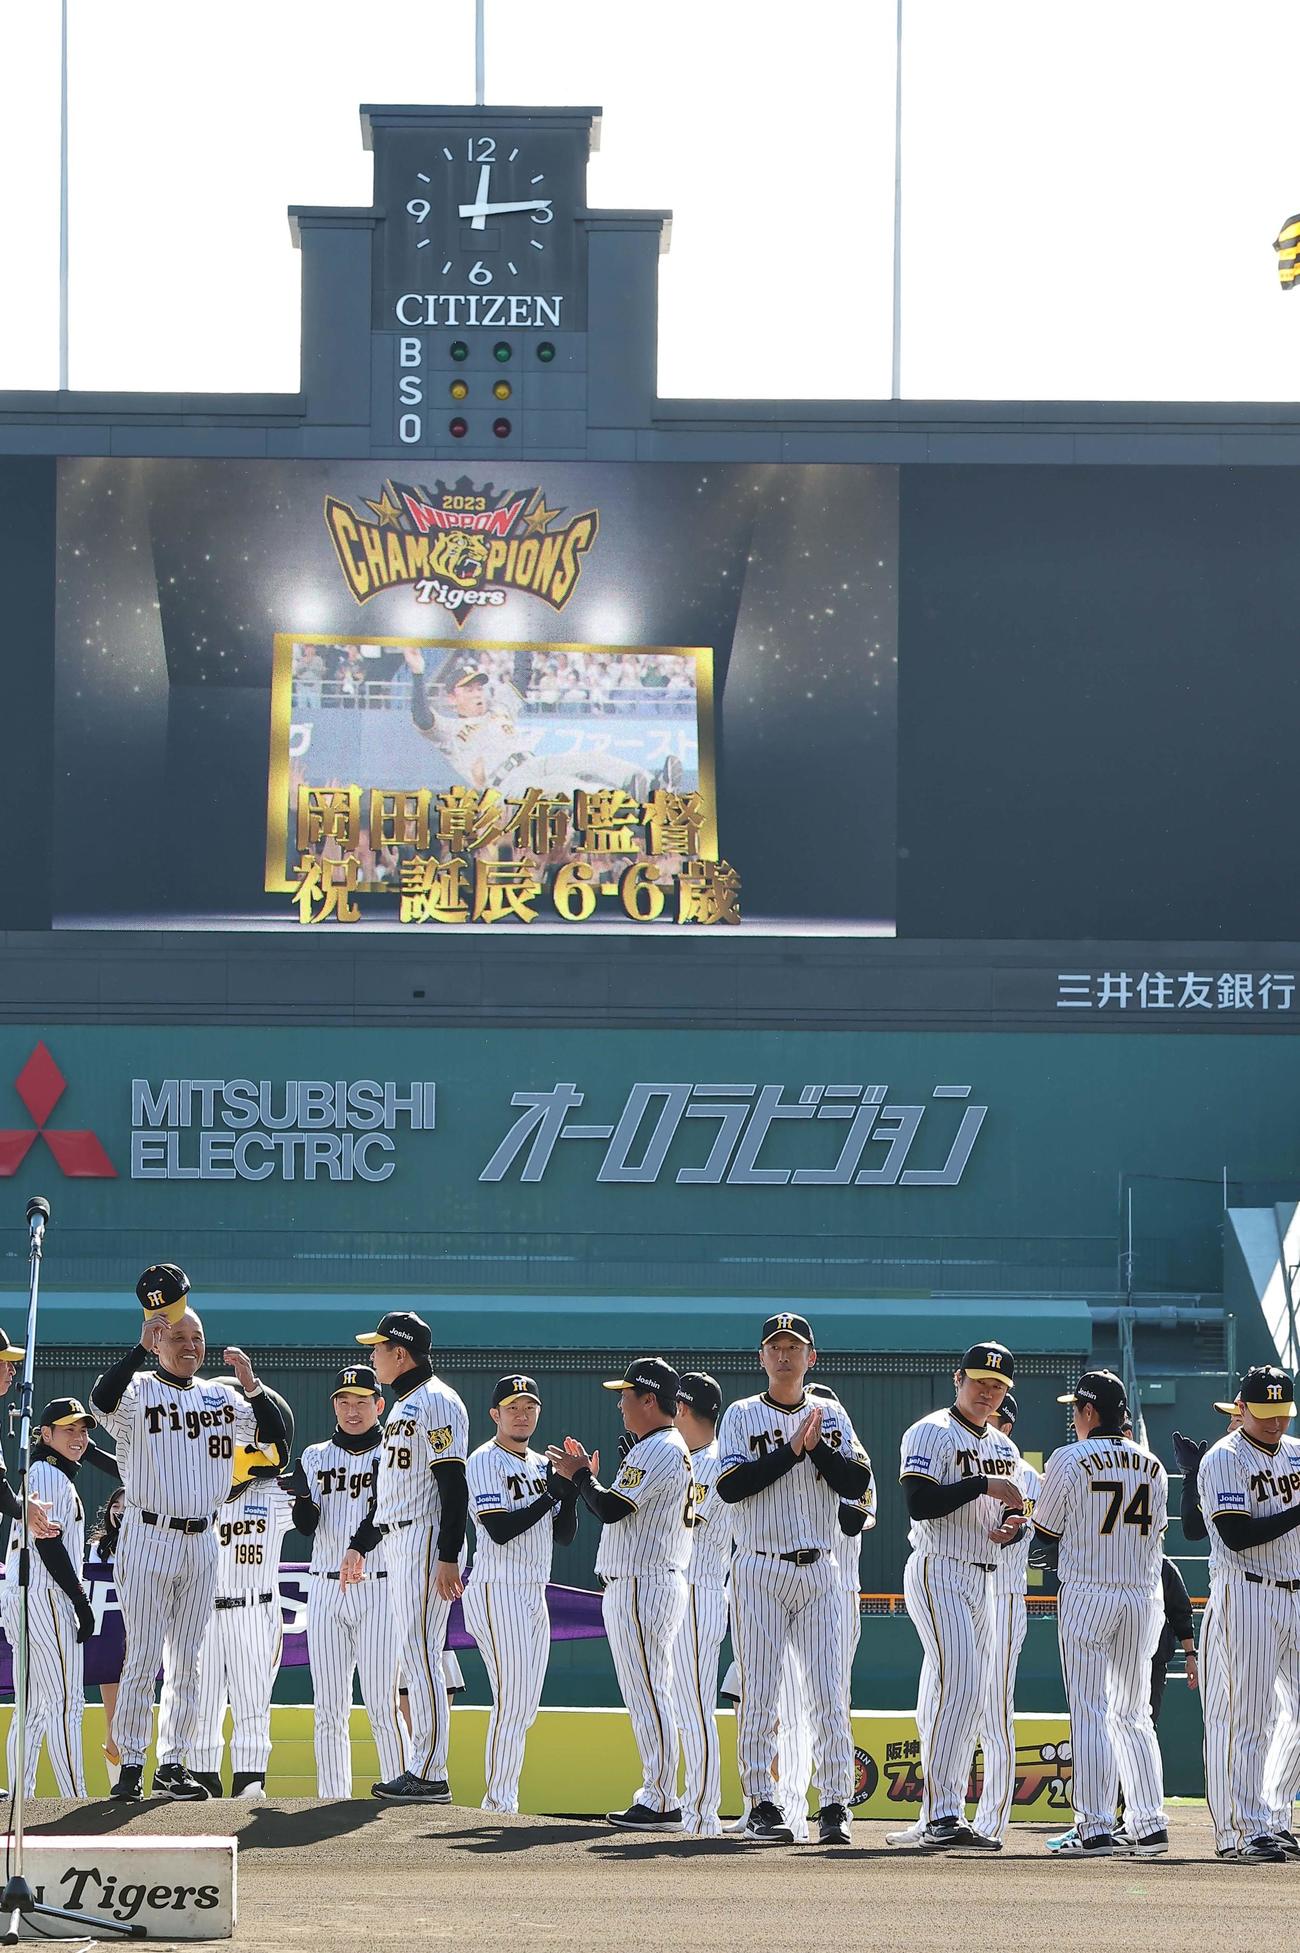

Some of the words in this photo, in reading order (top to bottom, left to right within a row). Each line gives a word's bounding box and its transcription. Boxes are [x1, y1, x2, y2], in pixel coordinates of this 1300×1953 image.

[467, 138, 496, 162] 12
[406, 199, 431, 224] 9
[468, 261, 493, 285] 6
[395, 294, 563, 326] CITIZEN
[400, 337, 422, 367] B
[399, 376, 423, 405] S
[402, 493, 525, 537] NIPPON
[442, 495, 486, 511] 2023
[332, 505, 592, 603] CHAMPIONS
[415, 580, 505, 609] Tigers
[296, 784, 705, 854] 岡田彰布監督
[292, 855, 361, 924] 祝
[1057, 972, 1295, 1009] 三井住友銀行
[131, 1079, 436, 1130] MITSUBISHI
[479, 1083, 988, 1185] オーロラビジョン
[131, 1131, 395, 1182] ELECTRIC
[389, 1327, 414, 1342] Joshin
[635, 1375, 660, 1390] Joshin
[1077, 1387, 1097, 1400] Joshin
[145, 1403, 235, 1439] Tigers
[384, 1419, 417, 1449] gers
[208, 1435, 233, 1459] 80
[387, 1446, 411, 1469] 78
[1080, 1451, 1160, 1478] FUJIMOTO
[317, 1467, 373, 1499] Tige
[1219, 1492, 1244, 1503] Joshin
[1250, 1470, 1300, 1504] Tige
[477, 1495, 500, 1504] Joshin
[1091, 1481, 1152, 1536] 74
[220, 1519, 266, 1546] gers
[235, 1544, 263, 1564] 1985
[60, 1867, 220, 1921] Tigers
